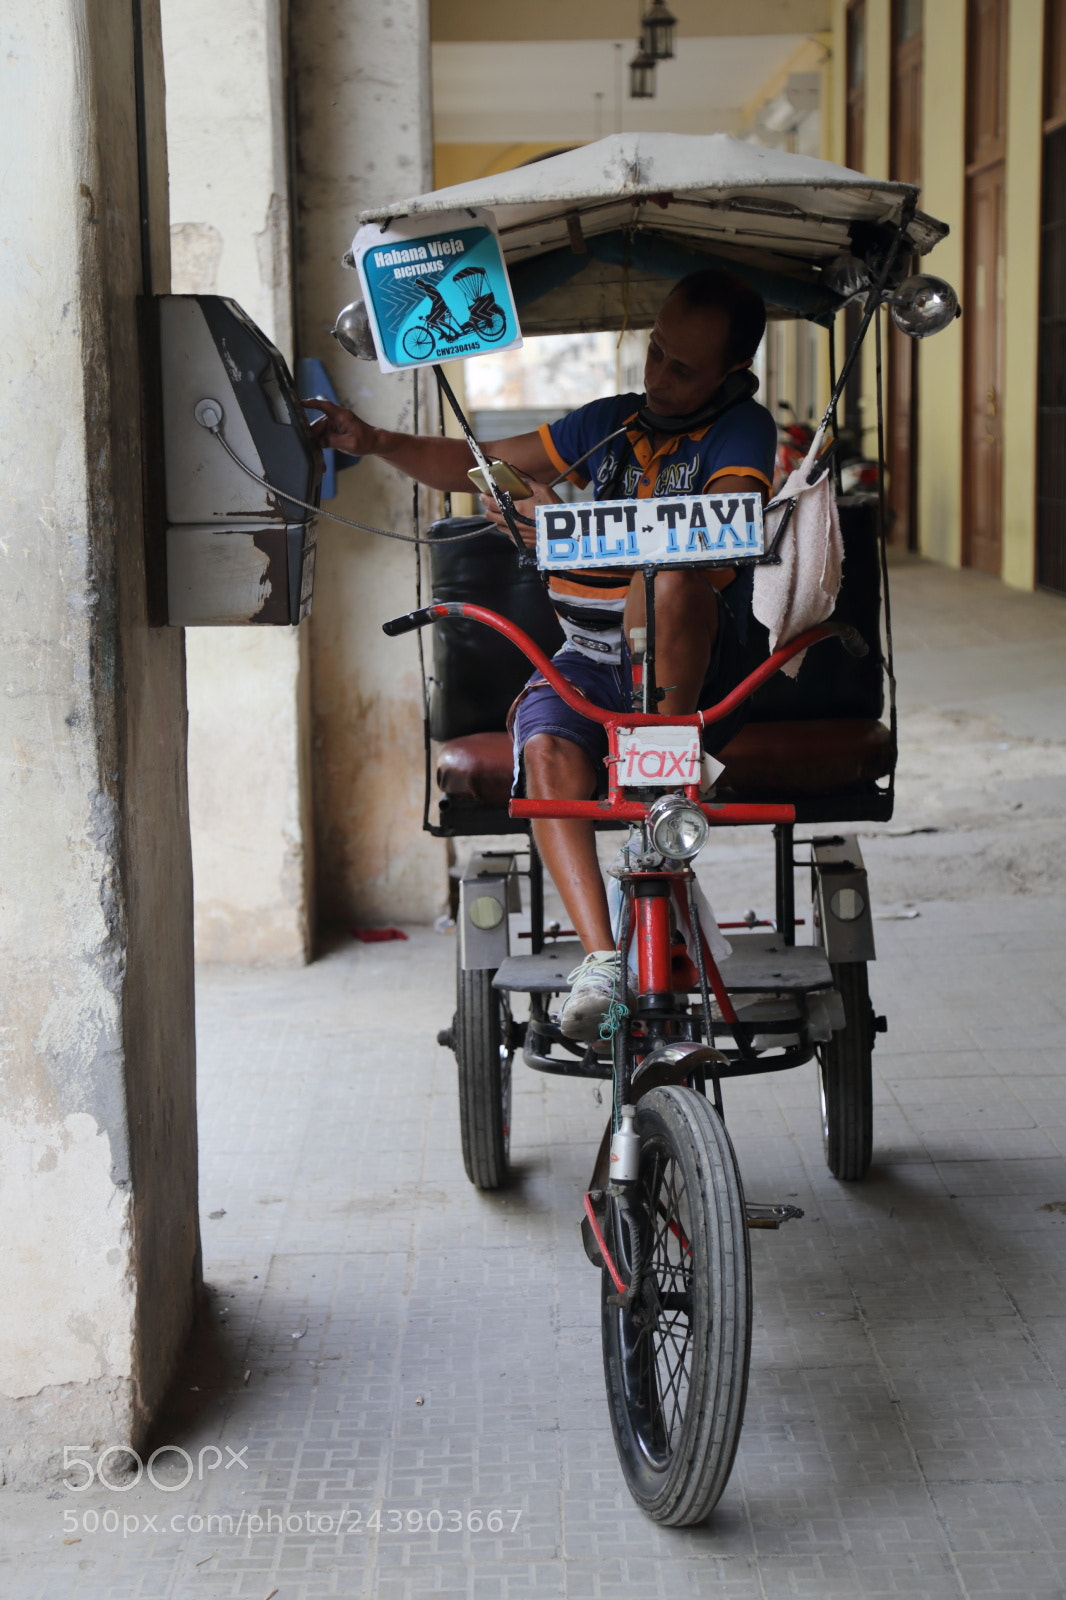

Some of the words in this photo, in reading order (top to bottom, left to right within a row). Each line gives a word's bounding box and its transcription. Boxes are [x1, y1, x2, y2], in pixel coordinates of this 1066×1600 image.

[374, 245, 428, 268] Habana
[428, 239, 465, 258] Vieja
[393, 260, 445, 279] BICITAXIS
[625, 743, 698, 778] taxi
